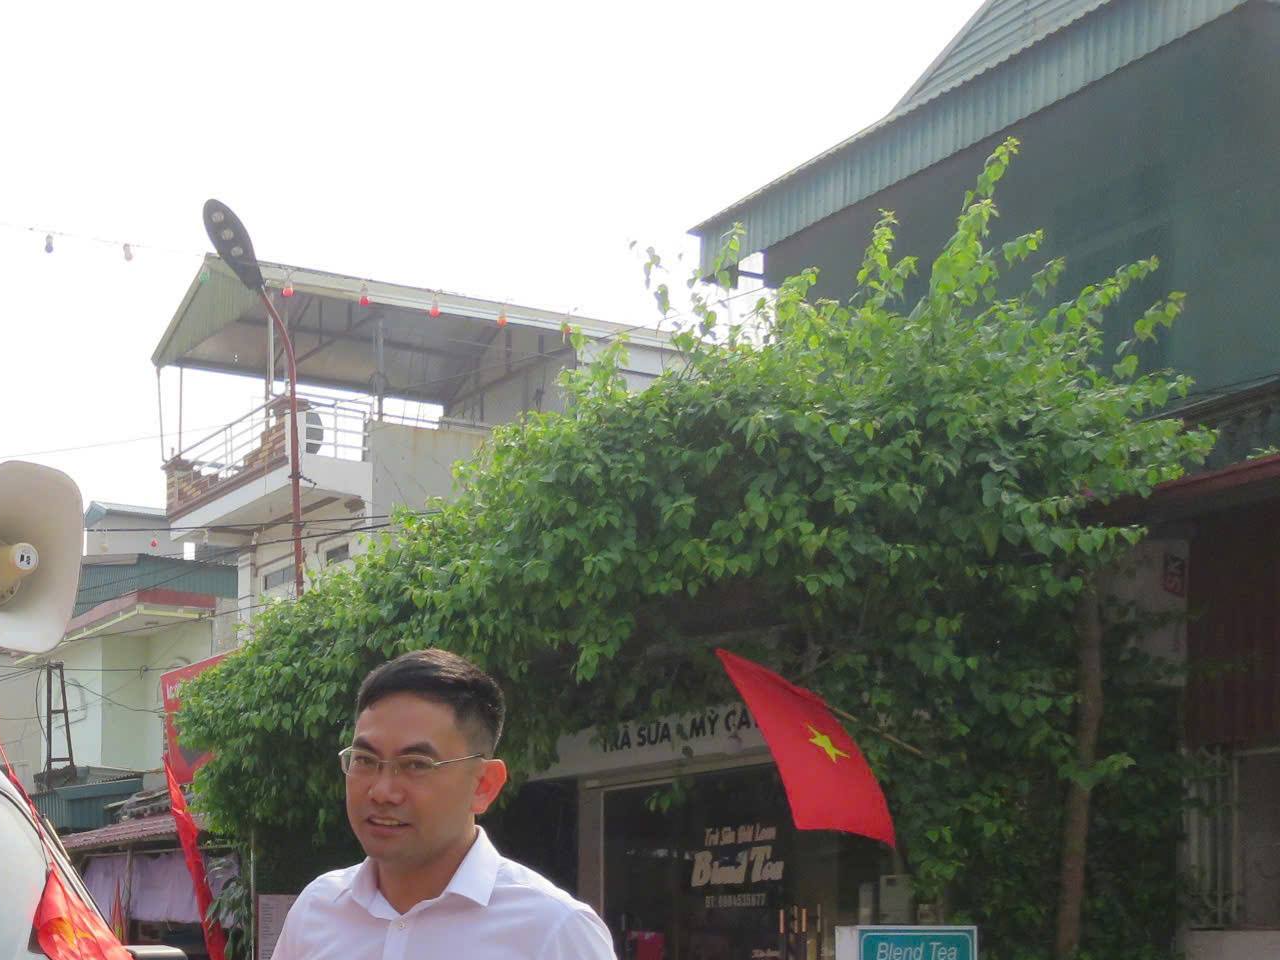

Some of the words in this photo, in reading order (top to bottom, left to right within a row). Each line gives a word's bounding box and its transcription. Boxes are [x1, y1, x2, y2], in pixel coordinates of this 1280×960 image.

[724, 708, 758, 732] CA
[876, 942, 924, 960] Blend
[929, 942, 958, 960] Tea
